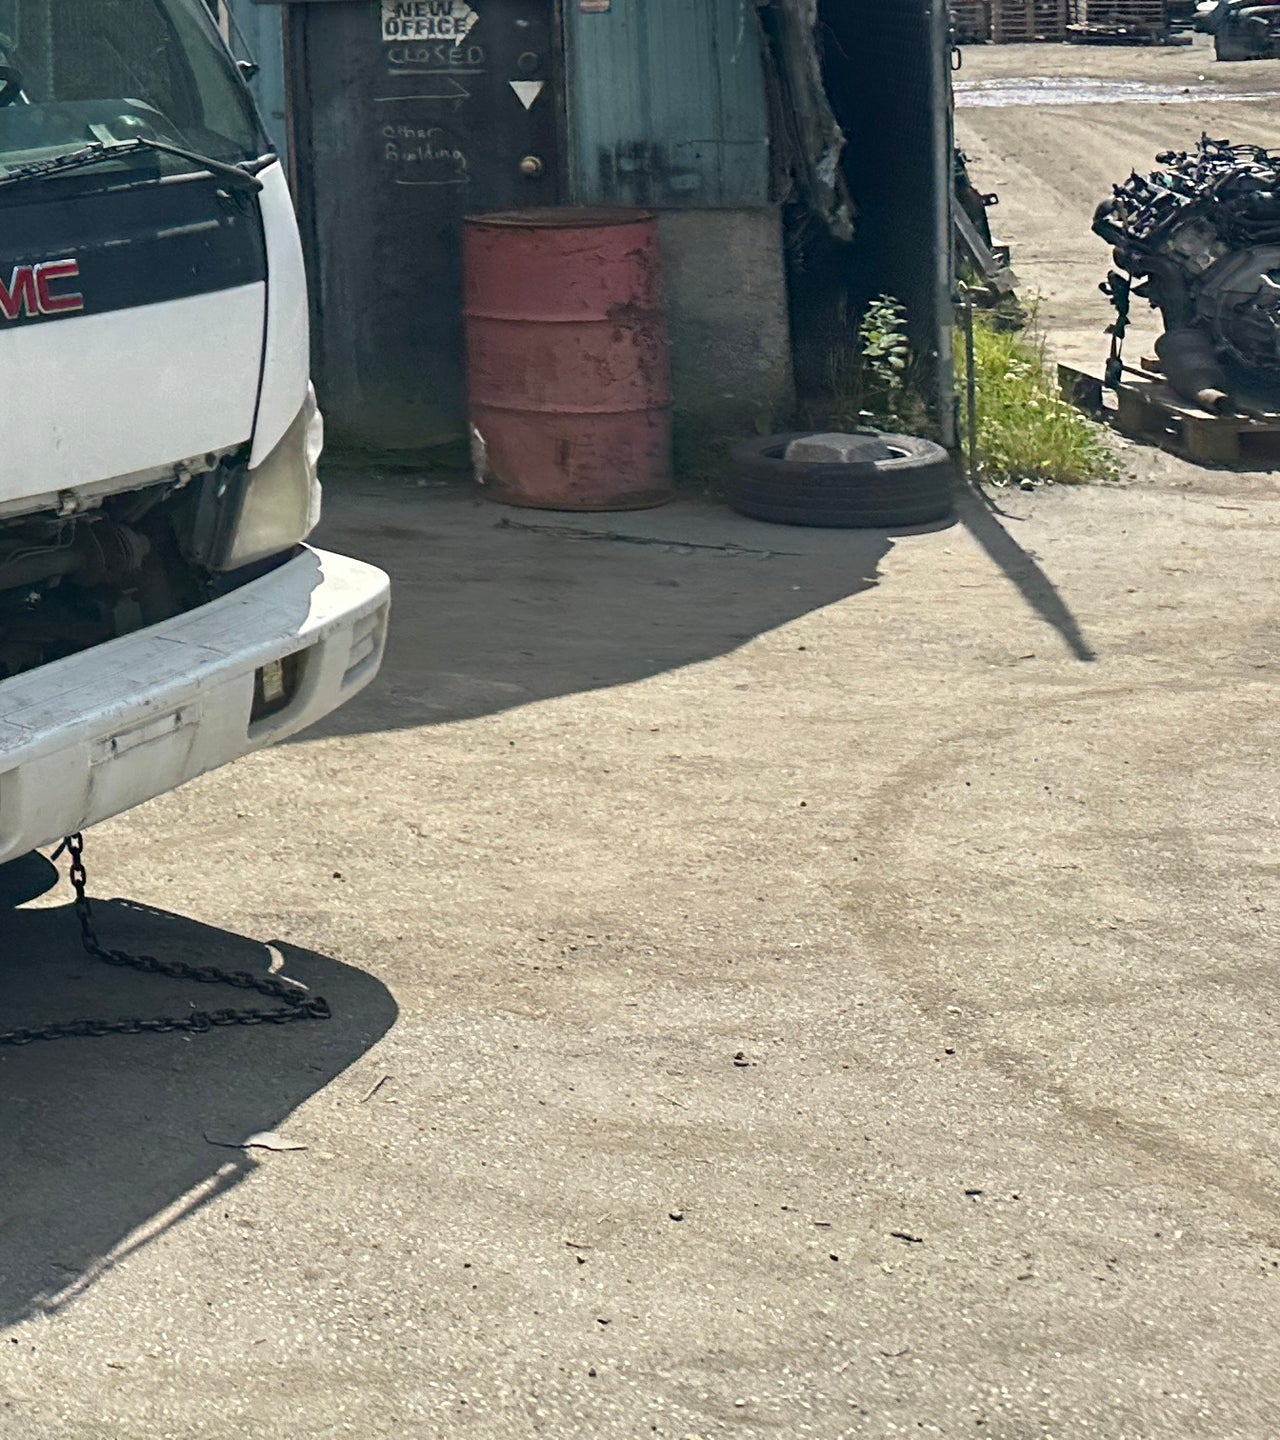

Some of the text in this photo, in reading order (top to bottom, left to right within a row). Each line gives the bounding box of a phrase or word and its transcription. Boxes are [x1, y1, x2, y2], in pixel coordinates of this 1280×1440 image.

[395, 0, 453, 18] NEW
[384, 17, 467, 36] OFFICE
[387, 44, 484, 65] CLOSED
